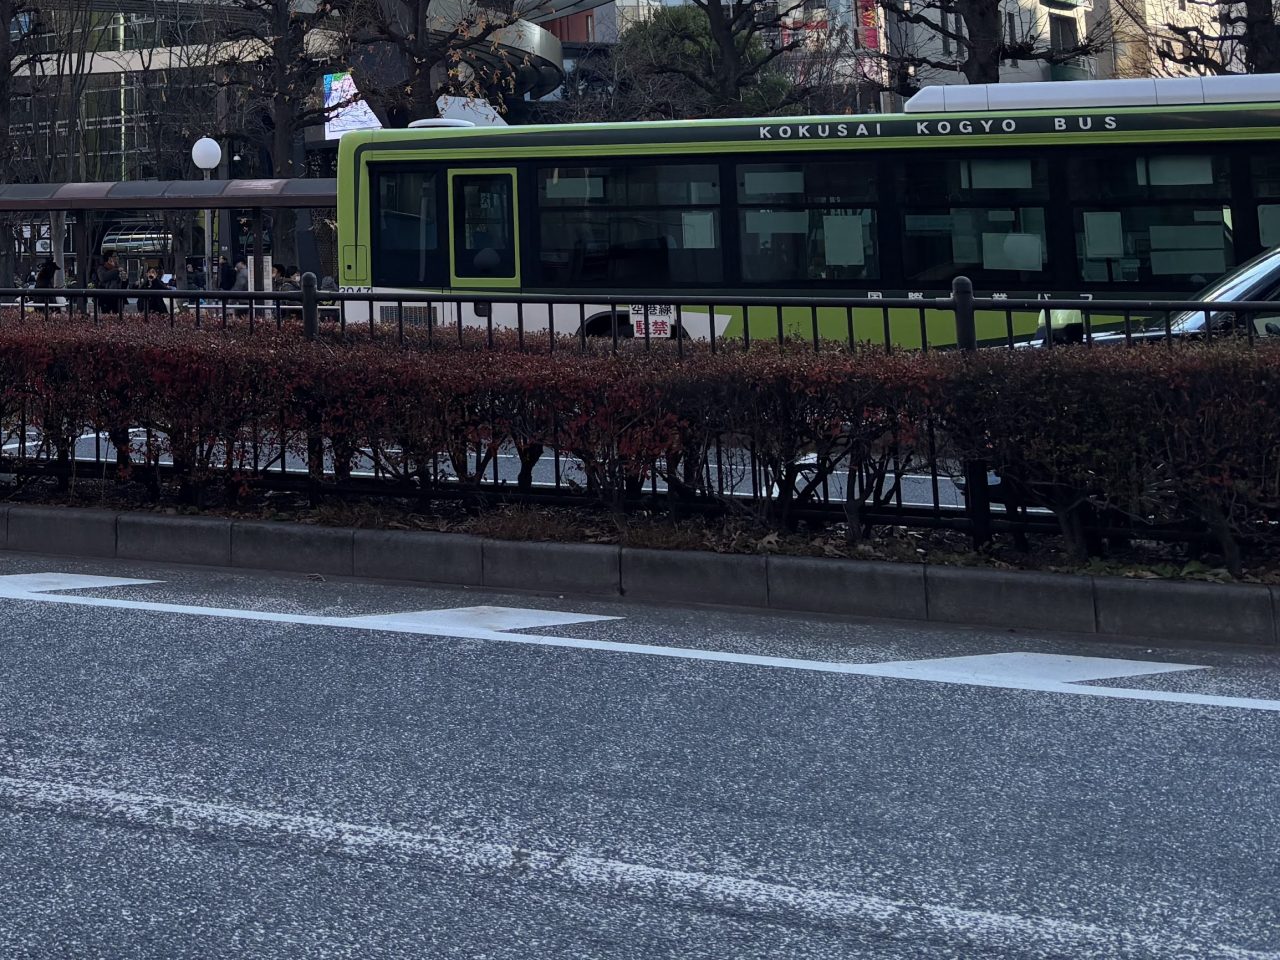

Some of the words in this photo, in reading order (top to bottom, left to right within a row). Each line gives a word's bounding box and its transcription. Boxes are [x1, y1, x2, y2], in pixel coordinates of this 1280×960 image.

[759, 123, 881, 139] KOKUSAI
[916, 118, 1017, 135] KOGYO
[1054, 116, 1117, 131] BUS
